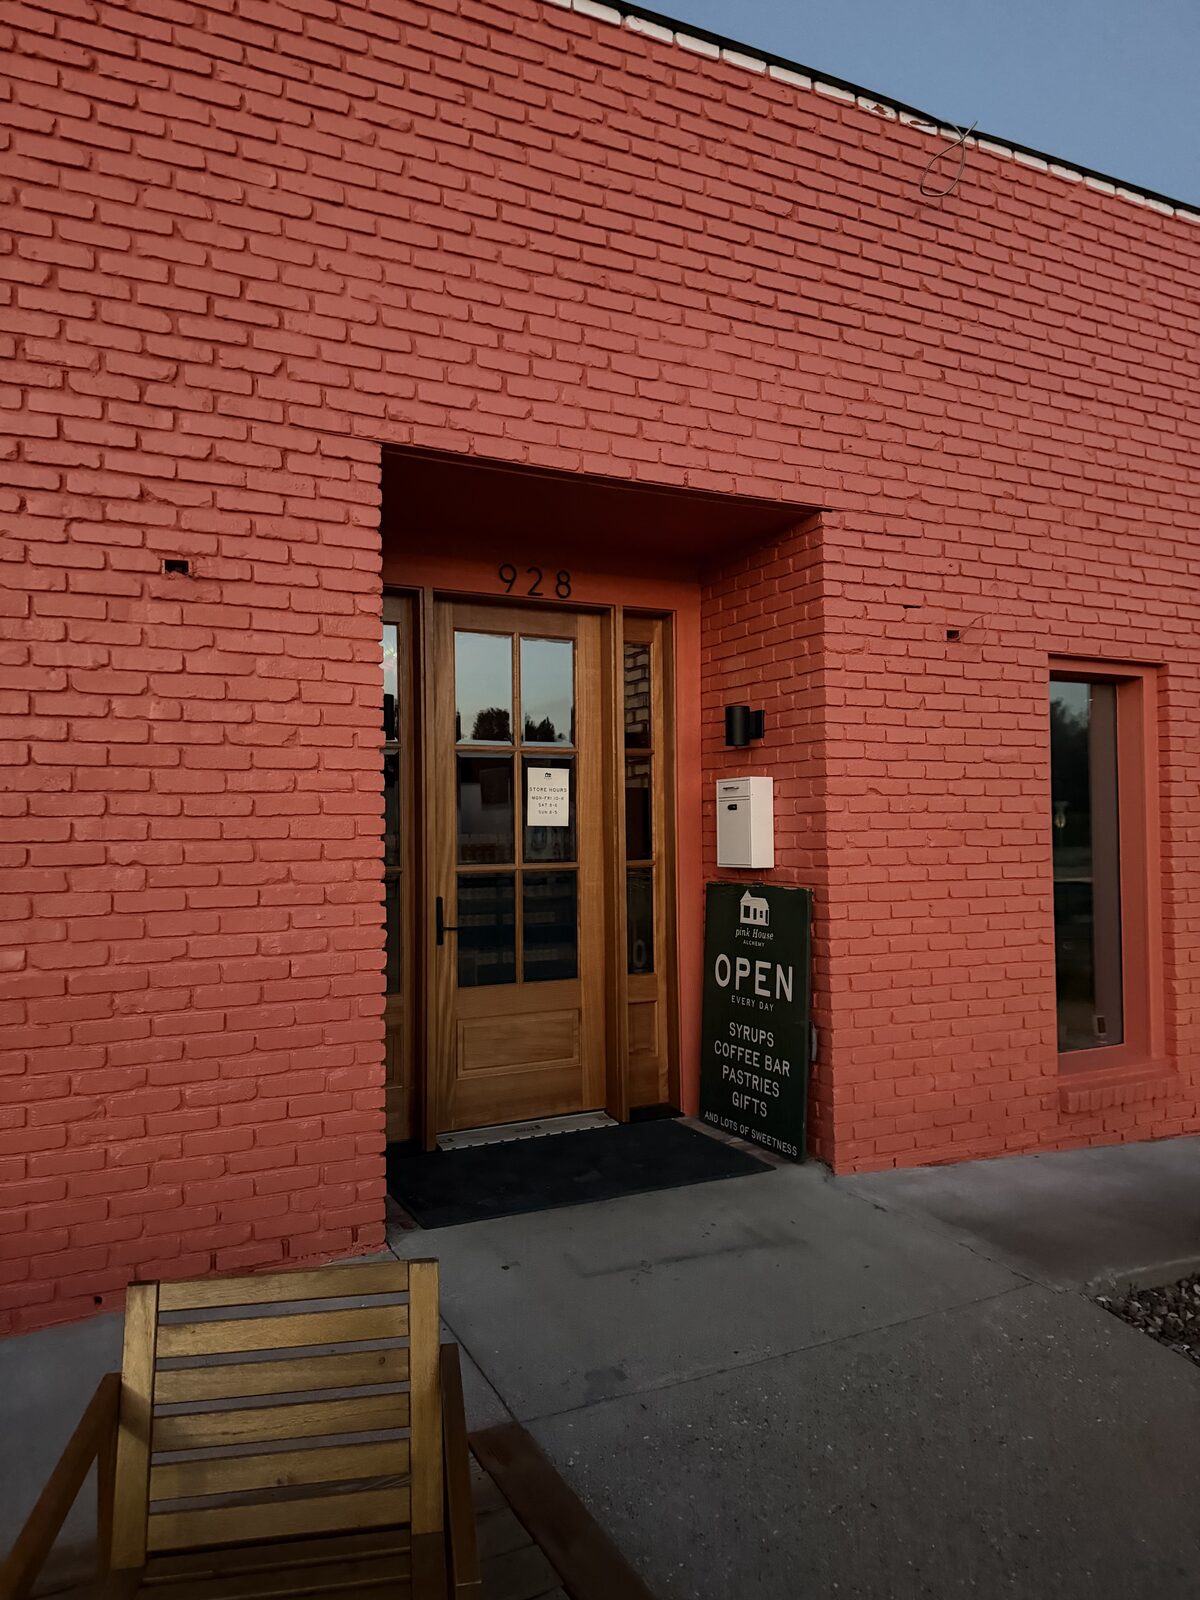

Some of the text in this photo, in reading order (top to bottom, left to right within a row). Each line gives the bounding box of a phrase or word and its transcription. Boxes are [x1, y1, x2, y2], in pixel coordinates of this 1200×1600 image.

[498, 563, 571, 599] 928
[735, 926, 774, 940] pink House
[714, 953, 793, 1002] OPEN
[731, 995, 774, 1012] EVERY DAY
[729, 1021, 774, 1048] SYRUPS
[714, 1040, 790, 1077] COFFEE BAR
[722, 1065, 780, 1098] PASTRIES
[732, 1091, 767, 1118] GIFTS
[704, 1111, 798, 1157] AND LOTS OF SWEETNESS
